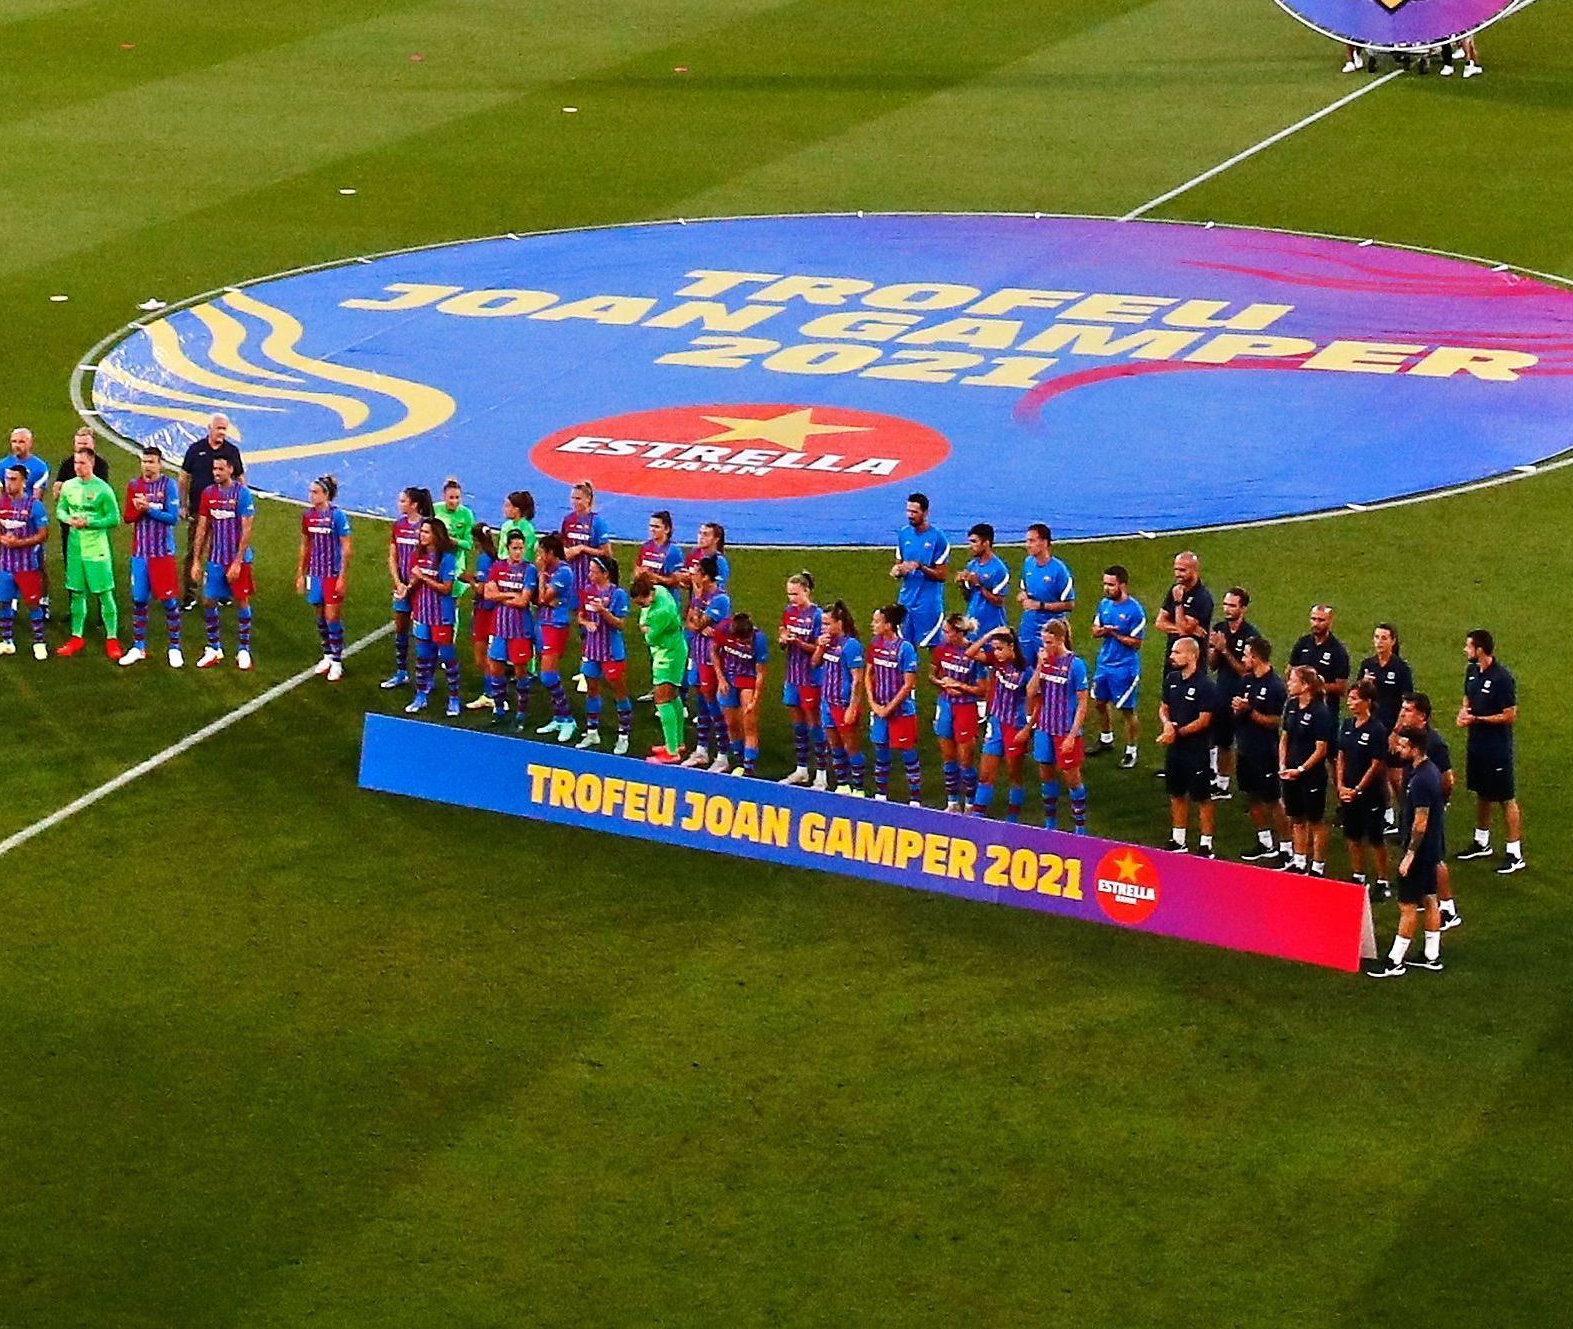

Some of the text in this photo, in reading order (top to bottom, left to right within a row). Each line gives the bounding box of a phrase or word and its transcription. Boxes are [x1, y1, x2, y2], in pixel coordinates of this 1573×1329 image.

[677, 269, 1294, 332] TROFEU
[339, 283, 1539, 382] JOAN GAMPER
[654, 336, 1062, 389] 2021
[555, 436, 900, 477] ESTRELLA
[646, 459, 774, 477] DAMM
[527, 763, 1084, 901] TROFEU JOAN GAMPER 2021
[1097, 879, 1156, 901] ESTRELLA
